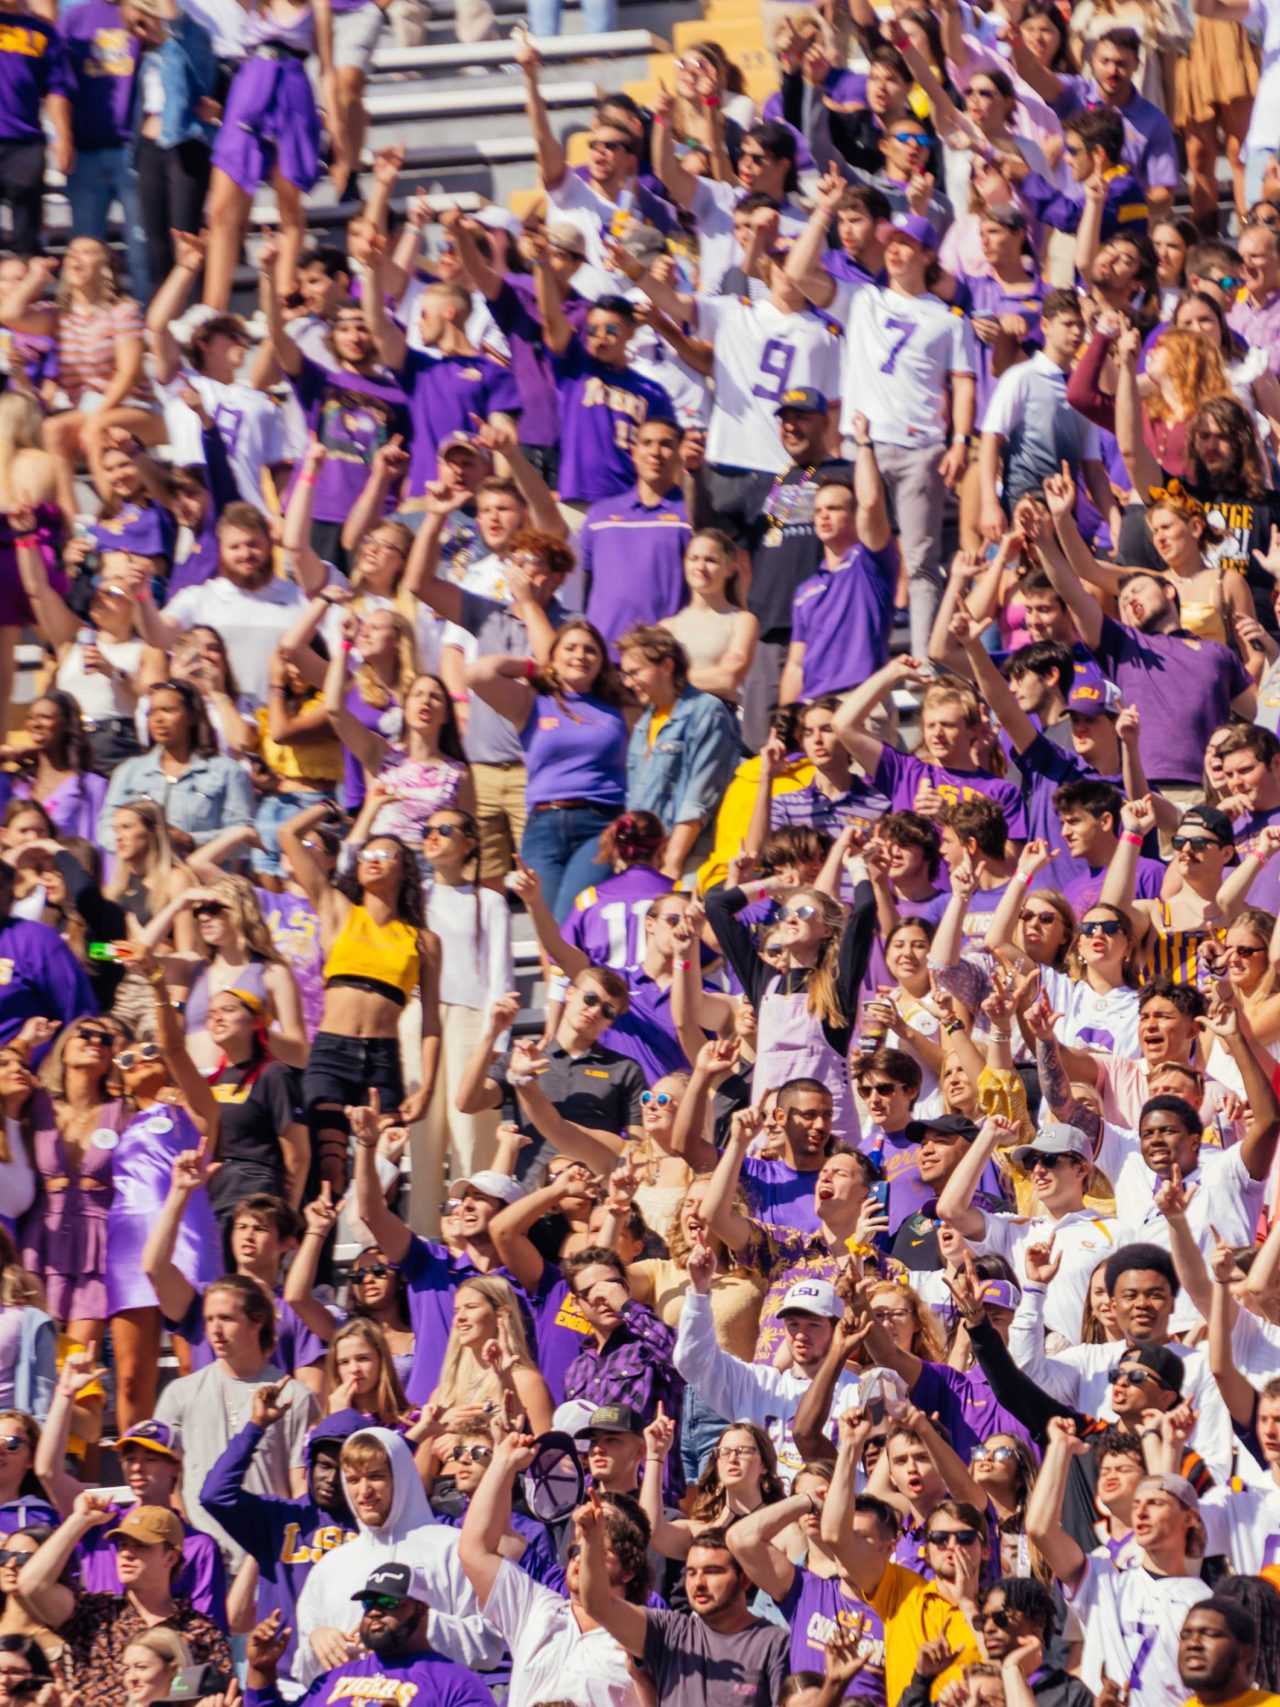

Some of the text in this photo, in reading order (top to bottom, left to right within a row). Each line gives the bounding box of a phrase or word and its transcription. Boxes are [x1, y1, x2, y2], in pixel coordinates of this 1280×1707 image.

[883, 317, 919, 375] 7
[751, 338, 797, 403] 9
[791, 1286, 820, 1297] LSU
[281, 1522, 358, 1565] LS
[325, 1673, 419, 1707] TIGERS
